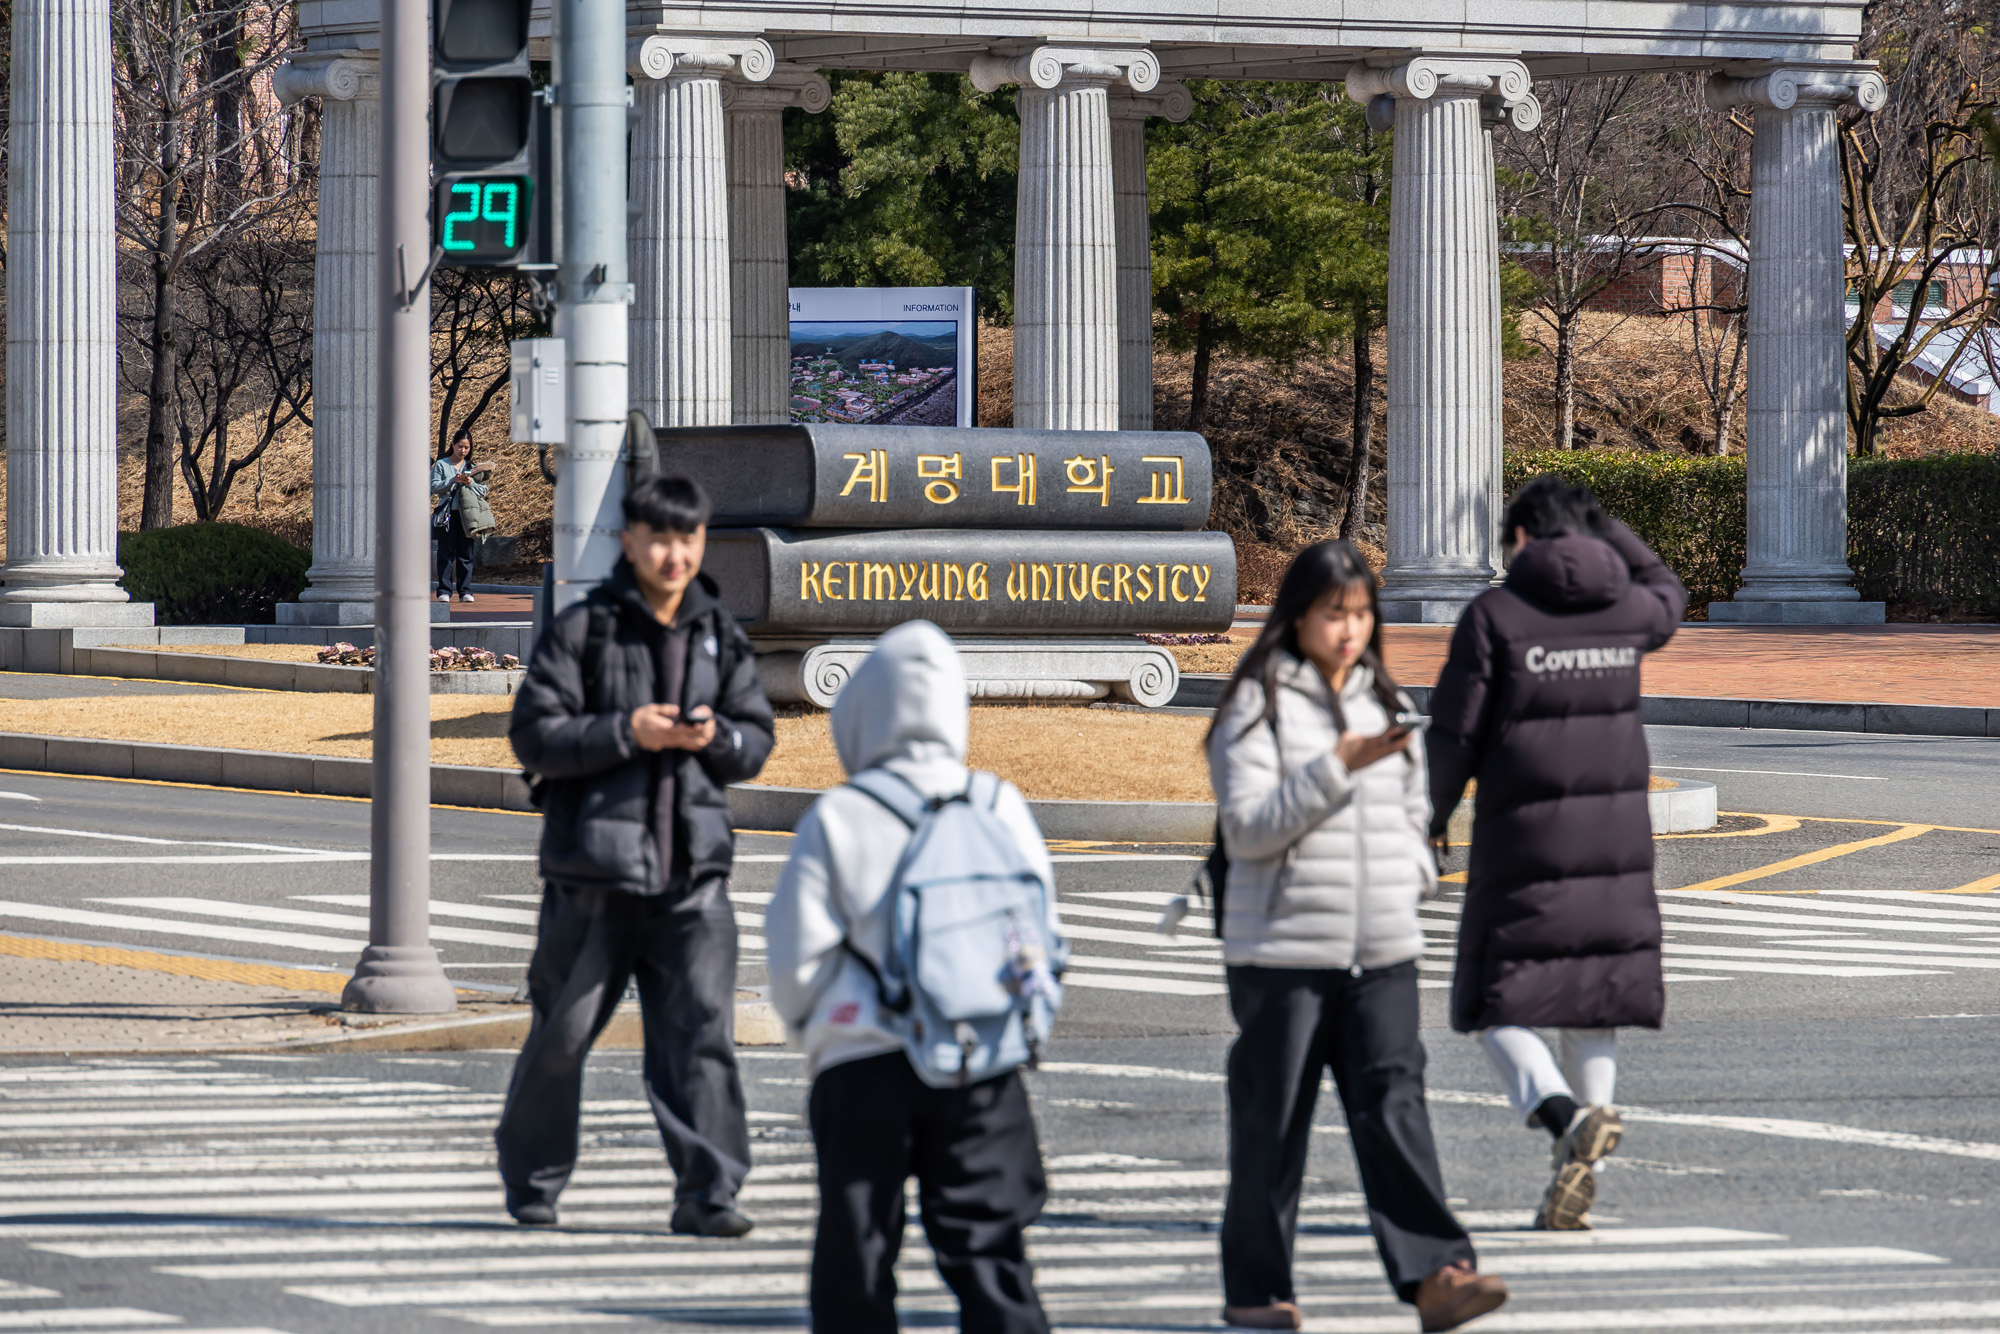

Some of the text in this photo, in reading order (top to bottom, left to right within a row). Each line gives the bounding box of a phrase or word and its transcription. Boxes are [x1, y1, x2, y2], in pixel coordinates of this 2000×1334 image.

[443, 183, 518, 251] 29
[903, 304, 959, 312] INFORMATION
[839, 448, 1191, 507] 계명대학교
[800, 560, 1212, 604] KEIMYUNG UNIVERSITY
